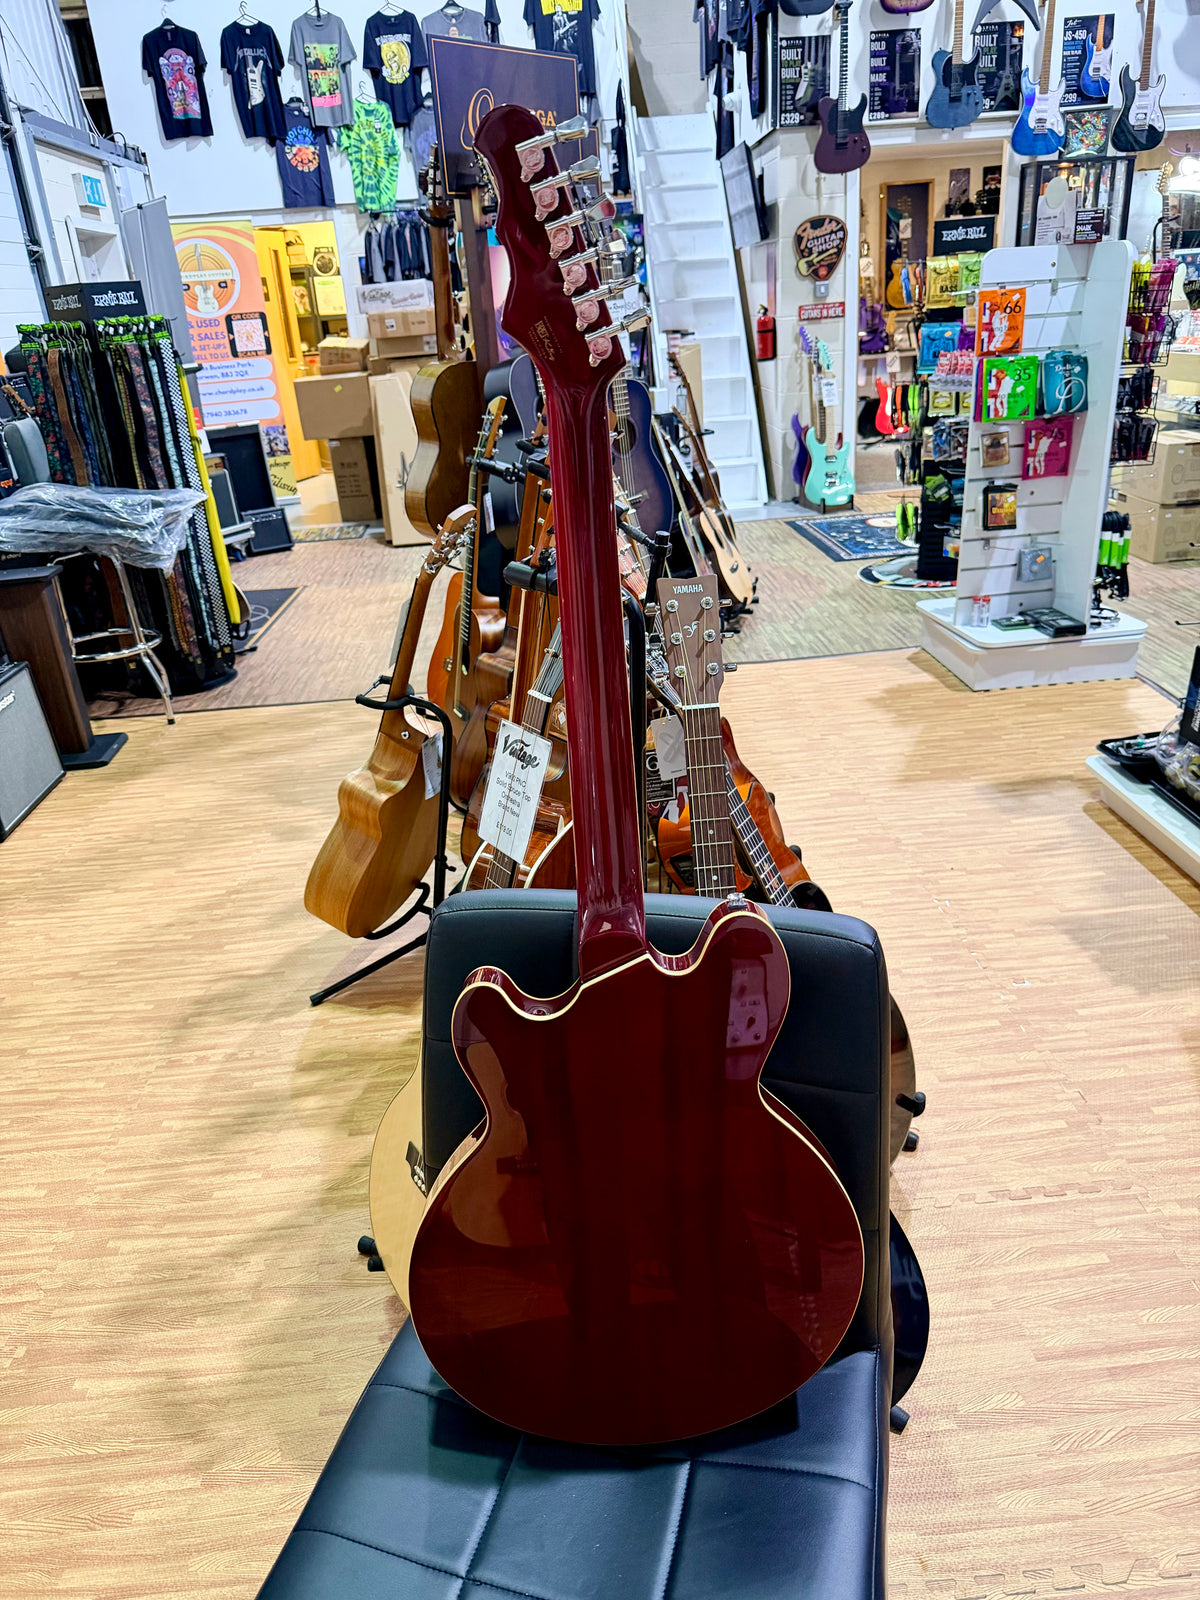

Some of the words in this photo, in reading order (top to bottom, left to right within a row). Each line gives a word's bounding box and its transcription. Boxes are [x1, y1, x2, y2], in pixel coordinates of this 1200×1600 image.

[975, 35, 998, 47] BUILT
[1064, 30, 1087, 41] JS-450
[870, 41, 886, 51] BOLD
[781, 49, 802, 60] BUILT
[870, 57, 887, 66] BUILT
[980, 55, 997, 67] UILT
[781, 68, 800, 78] BUILT
[870, 73, 887, 82] MADE
[942, 227, 967, 241] ERNIE
[967, 226, 987, 240] BALL
[807, 231, 844, 248] GUITAR
[811, 240, 840, 253] SHOP
[52, 295, 69, 311] ERNIE
[68, 294, 81, 308] BALL
[92, 290, 118, 307] ERNIE
[118, 291, 138, 305] BALL
[1003, 301, 1022, 314] 66
[196, 319, 220, 328] USED
[197, 331, 226, 341] SALES
[209, 352, 219, 360] TO
[209, 363, 235, 371] Business
[1013, 368, 1031, 381] 35
[672, 584, 703, 594] YAMAHA
[502, 734, 540, 770] Vintage
